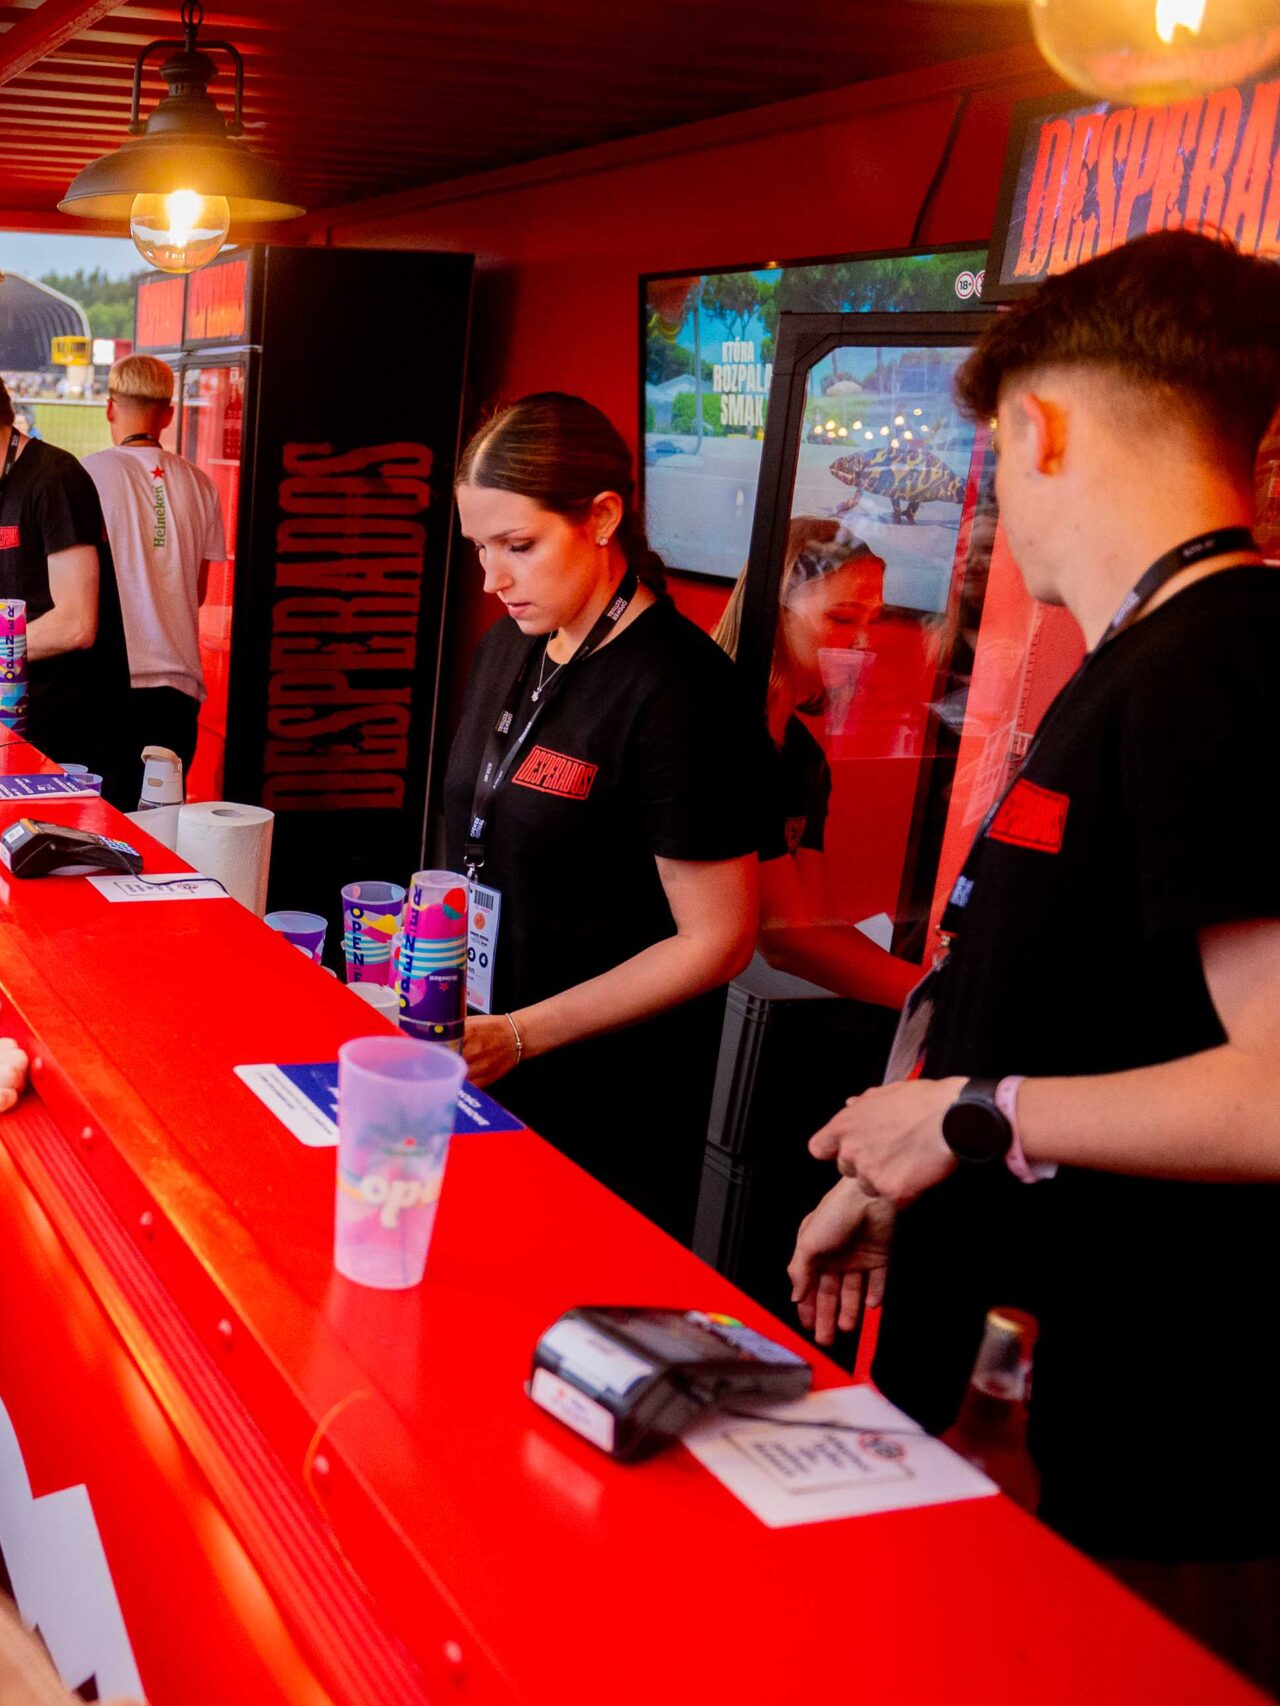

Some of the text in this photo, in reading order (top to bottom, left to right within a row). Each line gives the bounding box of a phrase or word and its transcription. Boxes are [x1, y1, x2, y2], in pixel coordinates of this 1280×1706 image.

[959, 281, 972, 290] 18+
[722, 336, 754, 362] KTÓRA
[721, 394, 764, 426] SMAK
[153, 485, 166, 547] Heineken
[262, 441, 433, 810] DESPERADOS
[517, 749, 593, 795] DESPERADOS
